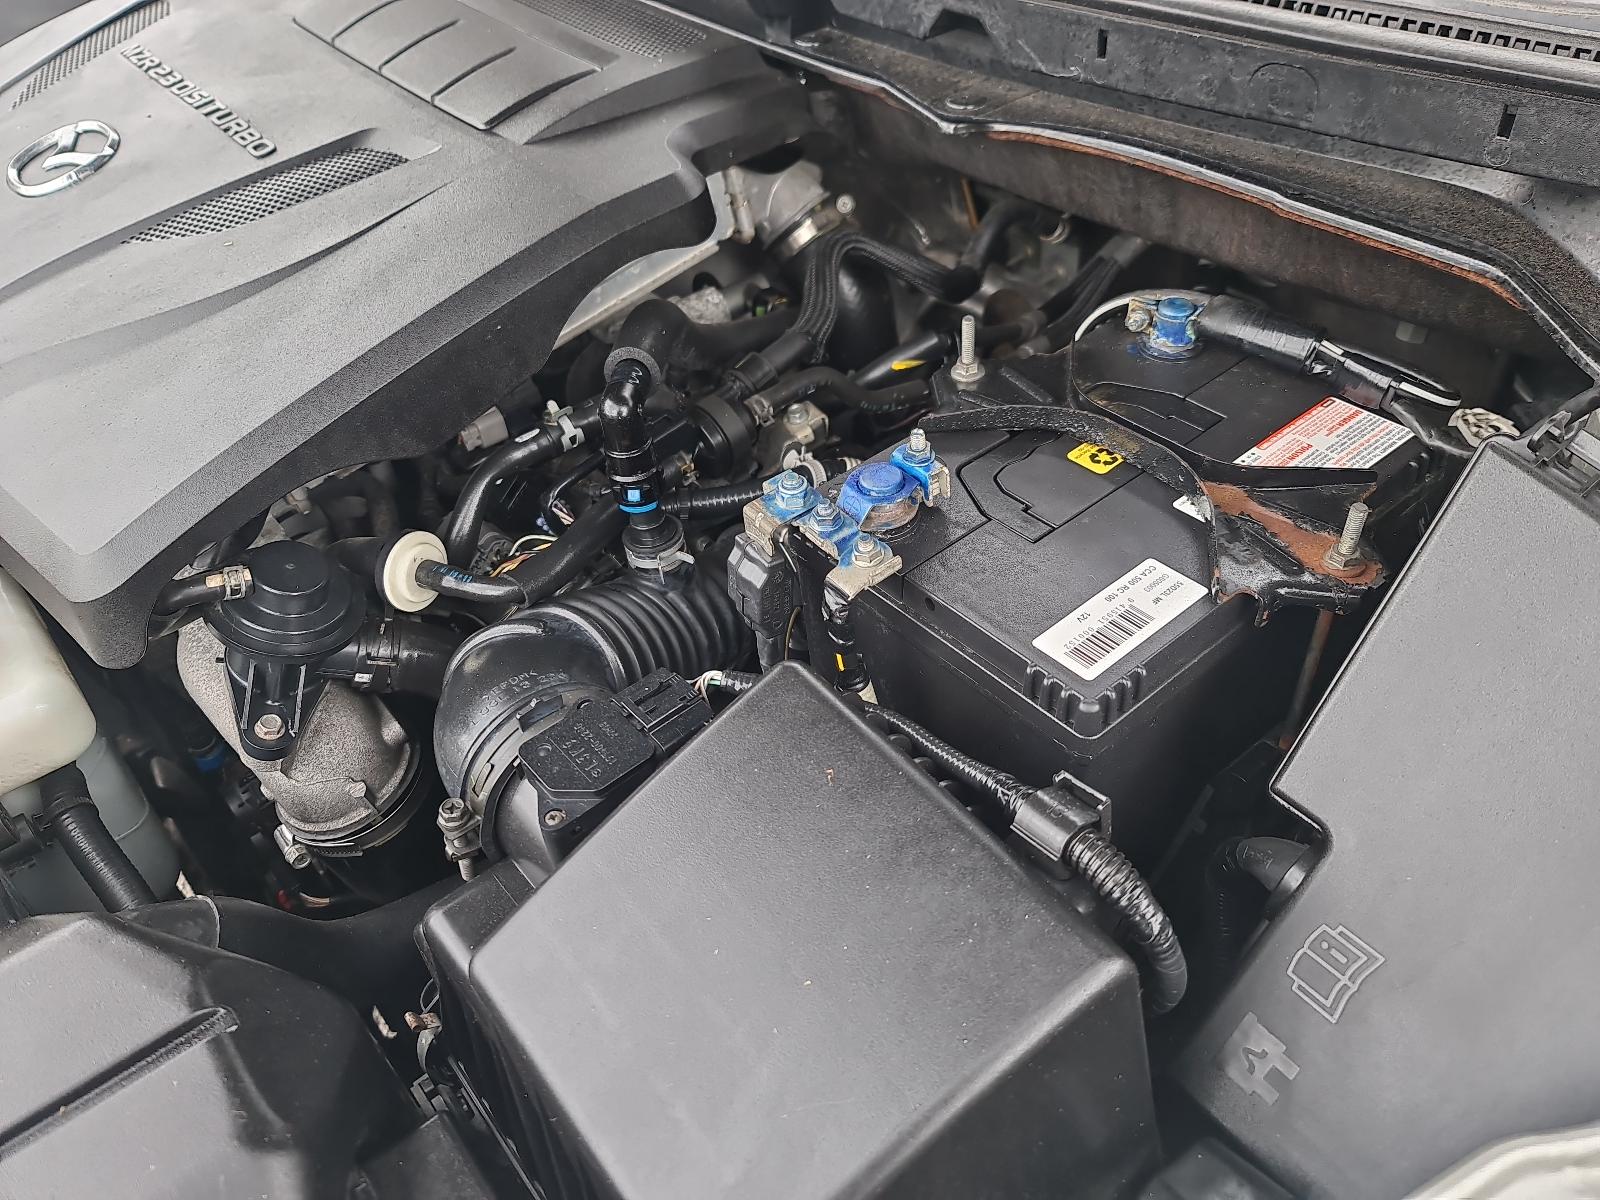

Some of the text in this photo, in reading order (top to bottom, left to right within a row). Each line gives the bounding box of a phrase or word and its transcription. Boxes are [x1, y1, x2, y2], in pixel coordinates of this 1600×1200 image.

[1287, 443, 1313, 460] POISON
[1104, 565, 1157, 602] CCA 500 RC 100
[1076, 611, 1091, 623] 12V
